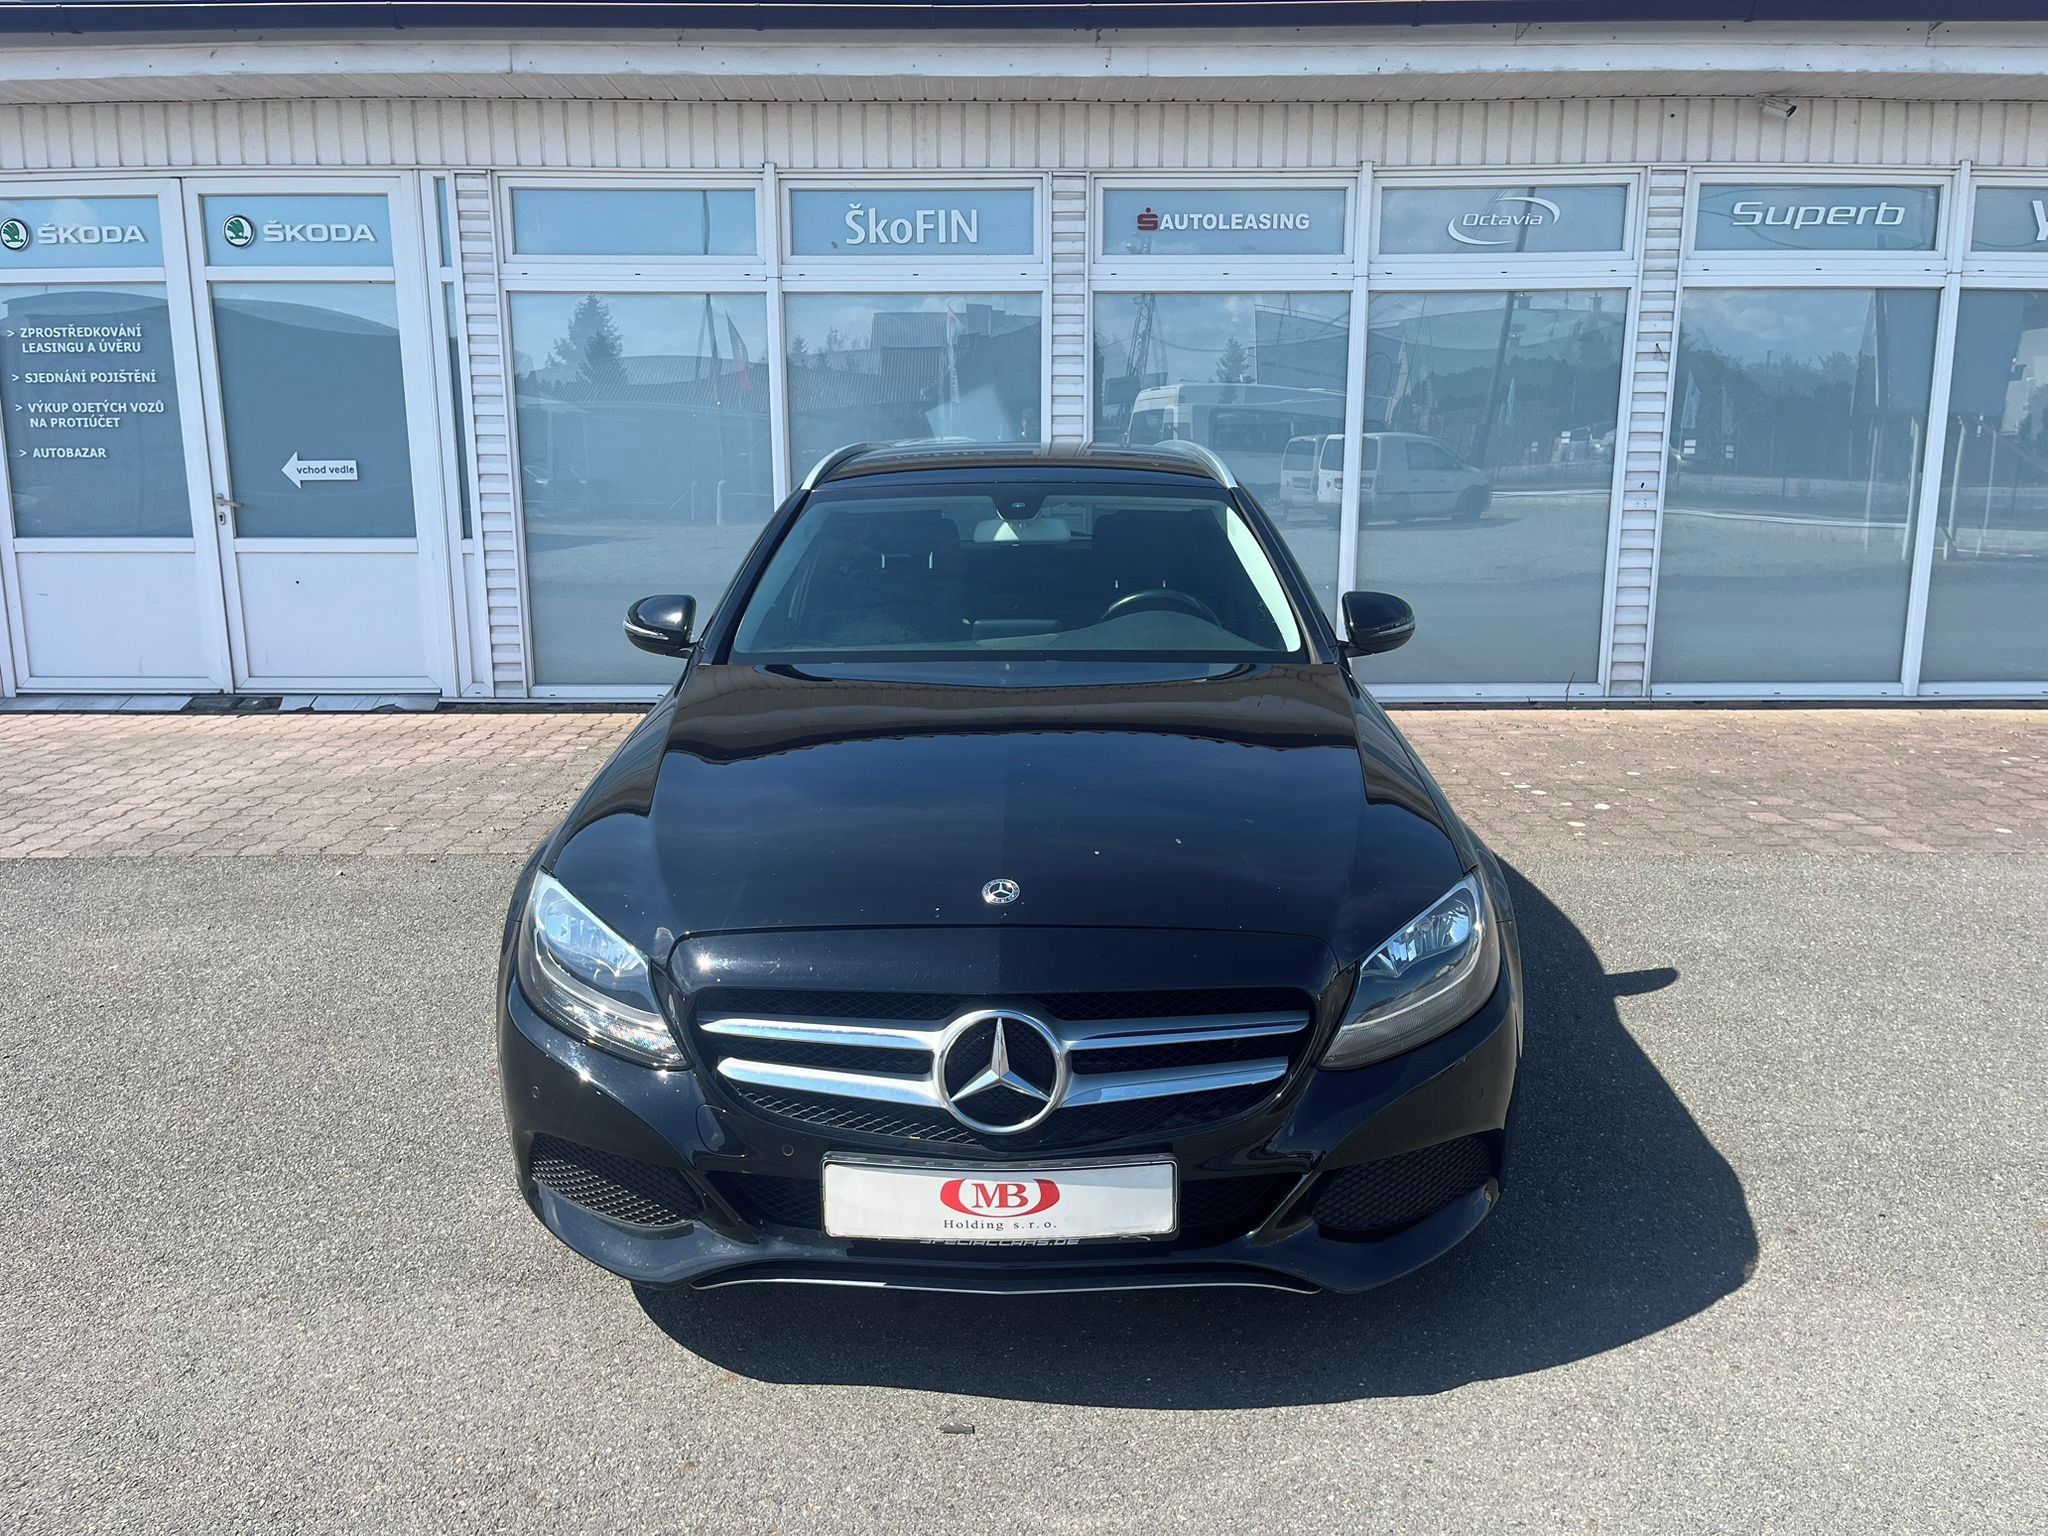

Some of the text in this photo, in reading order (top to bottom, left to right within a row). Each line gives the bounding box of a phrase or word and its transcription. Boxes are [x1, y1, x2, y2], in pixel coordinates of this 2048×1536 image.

[1462, 213, 1543, 226] Octavia
[1732, 201, 1906, 230] Superb
[845, 203, 978, 245] ŠkoFIN
[37, 223, 146, 244] ŠKODA
[263, 221, 376, 242] ŠKODA
[20, 323, 142, 338] ZPROSTŘEDKOVÁNÍ
[22, 339, 141, 353] LEASINGU A ÚVĚRU
[25, 369, 157, 383] SJEDNÁNÍ POJIŠTĚNÍ
[28, 400, 165, 413] VÝKUP OJETÝCH VOZŮ
[30, 415, 120, 428] NA PROTIÚČET
[32, 448, 107, 458] AUTOBAZAR
[296, 466, 355, 474] vchod vedle
[971, 1183, 1029, 1209] MB
[943, 1220, 1004, 1231] Holding
